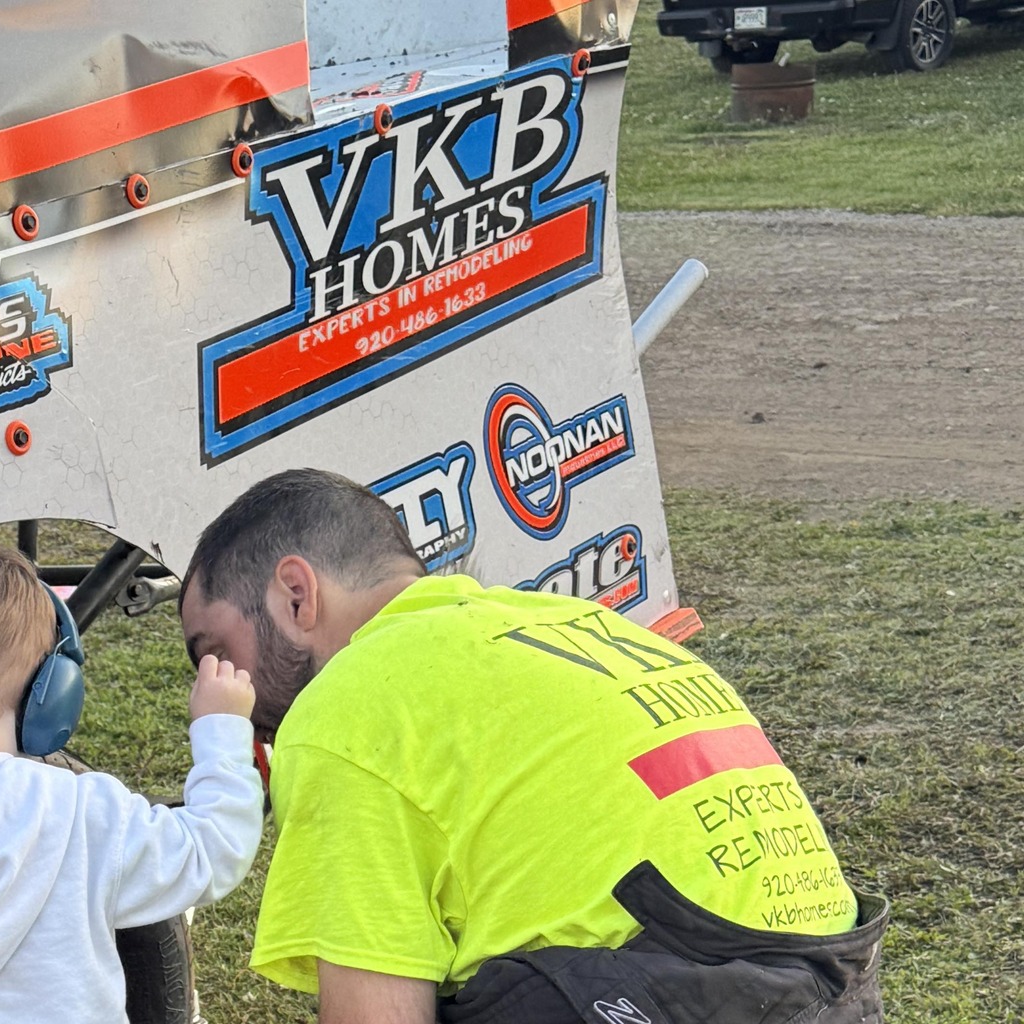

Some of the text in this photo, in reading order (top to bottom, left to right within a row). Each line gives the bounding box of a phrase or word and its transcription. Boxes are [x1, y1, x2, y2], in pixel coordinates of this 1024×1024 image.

[266, 73, 570, 263] VKB
[308, 186, 526, 323] HOMES
[298, 233, 534, 353] EXPERTS IN REMODELING
[505, 406, 625, 488] NOONAN
[492, 609, 704, 680] VK
[621, 673, 744, 730] HOME
[692, 781, 803, 834] EXPERTS
[705, 822, 827, 878] REMODEL
